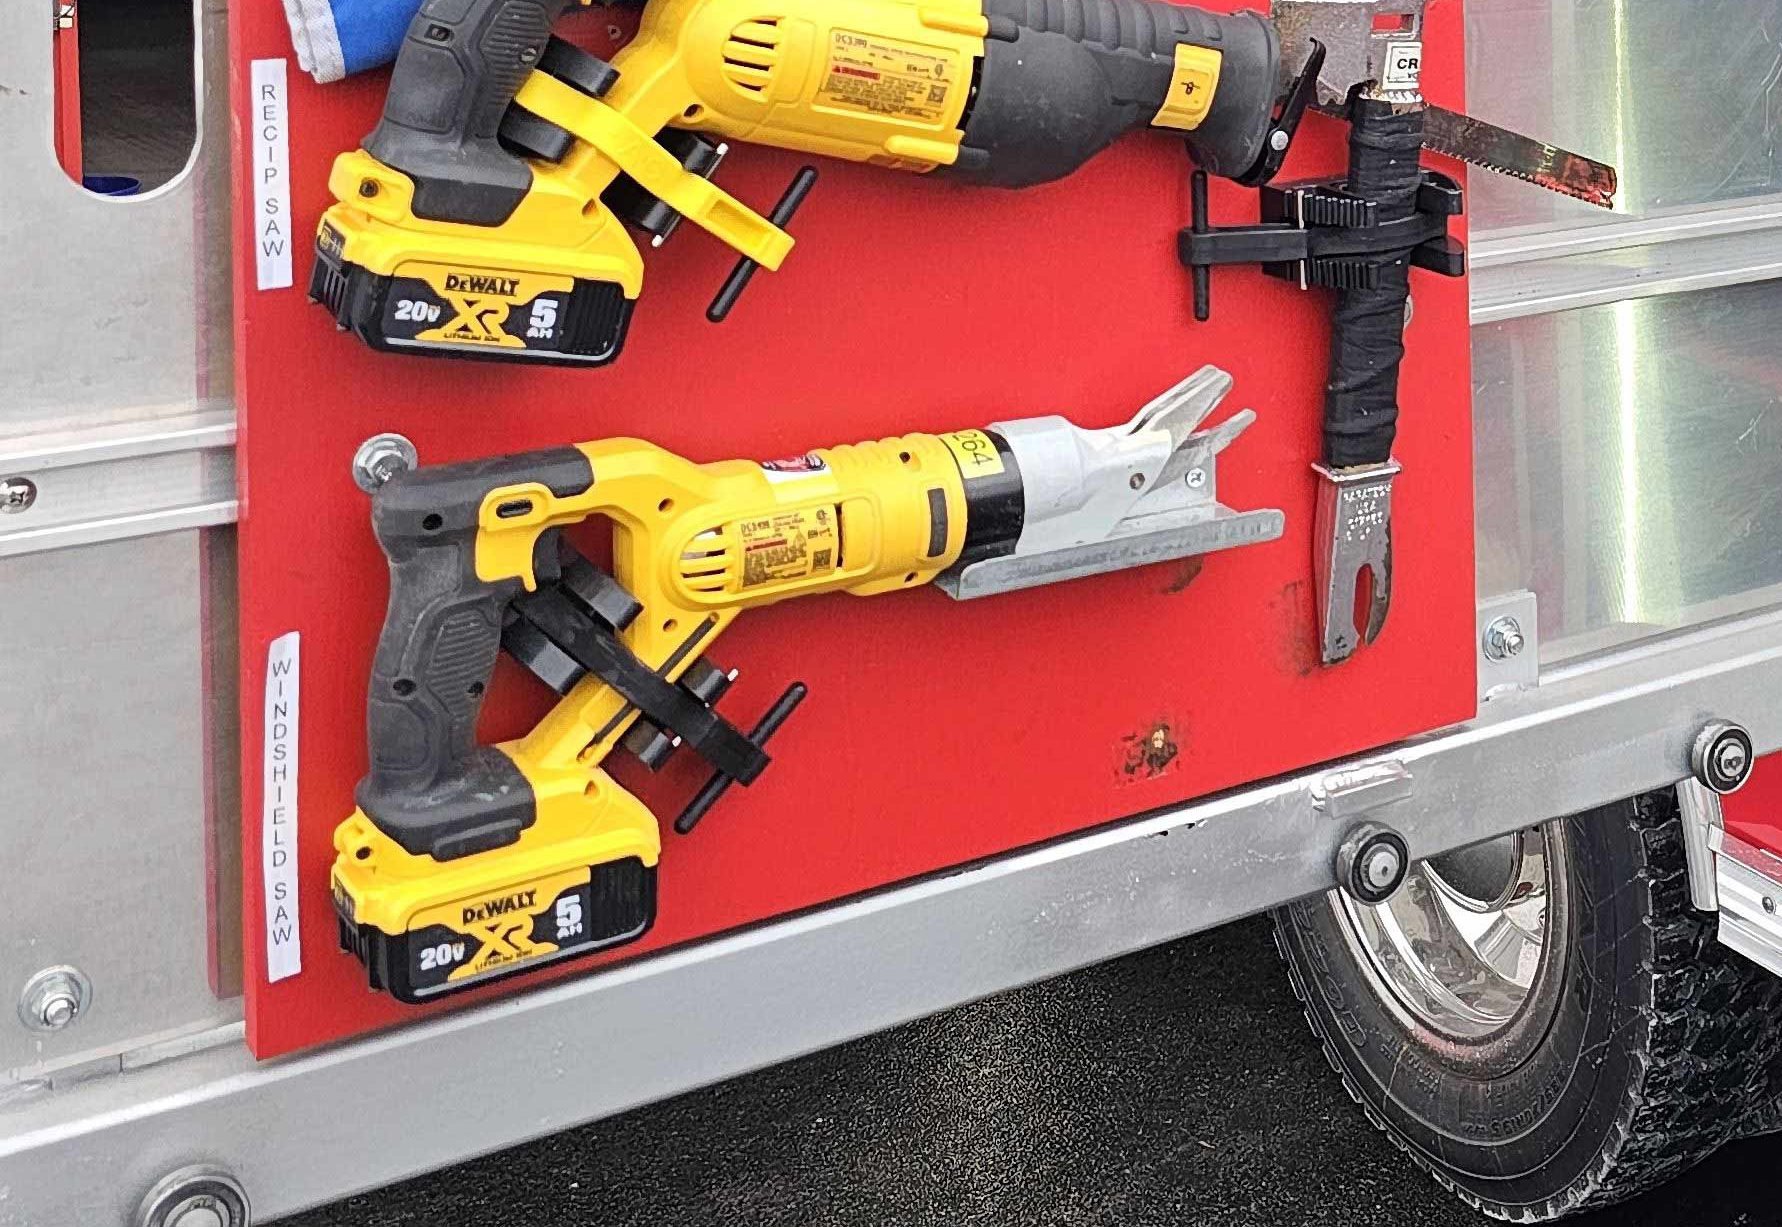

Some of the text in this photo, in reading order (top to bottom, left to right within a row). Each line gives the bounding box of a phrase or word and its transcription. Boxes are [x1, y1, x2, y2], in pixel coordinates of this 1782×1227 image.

[262, 84, 284, 257] RECIP SAW
[529, 298, 559, 328] 5
[952, 432, 994, 466] 264
[272, 658, 292, 946] WINDSHIELD SAW
[556, 894, 582, 927] 5
